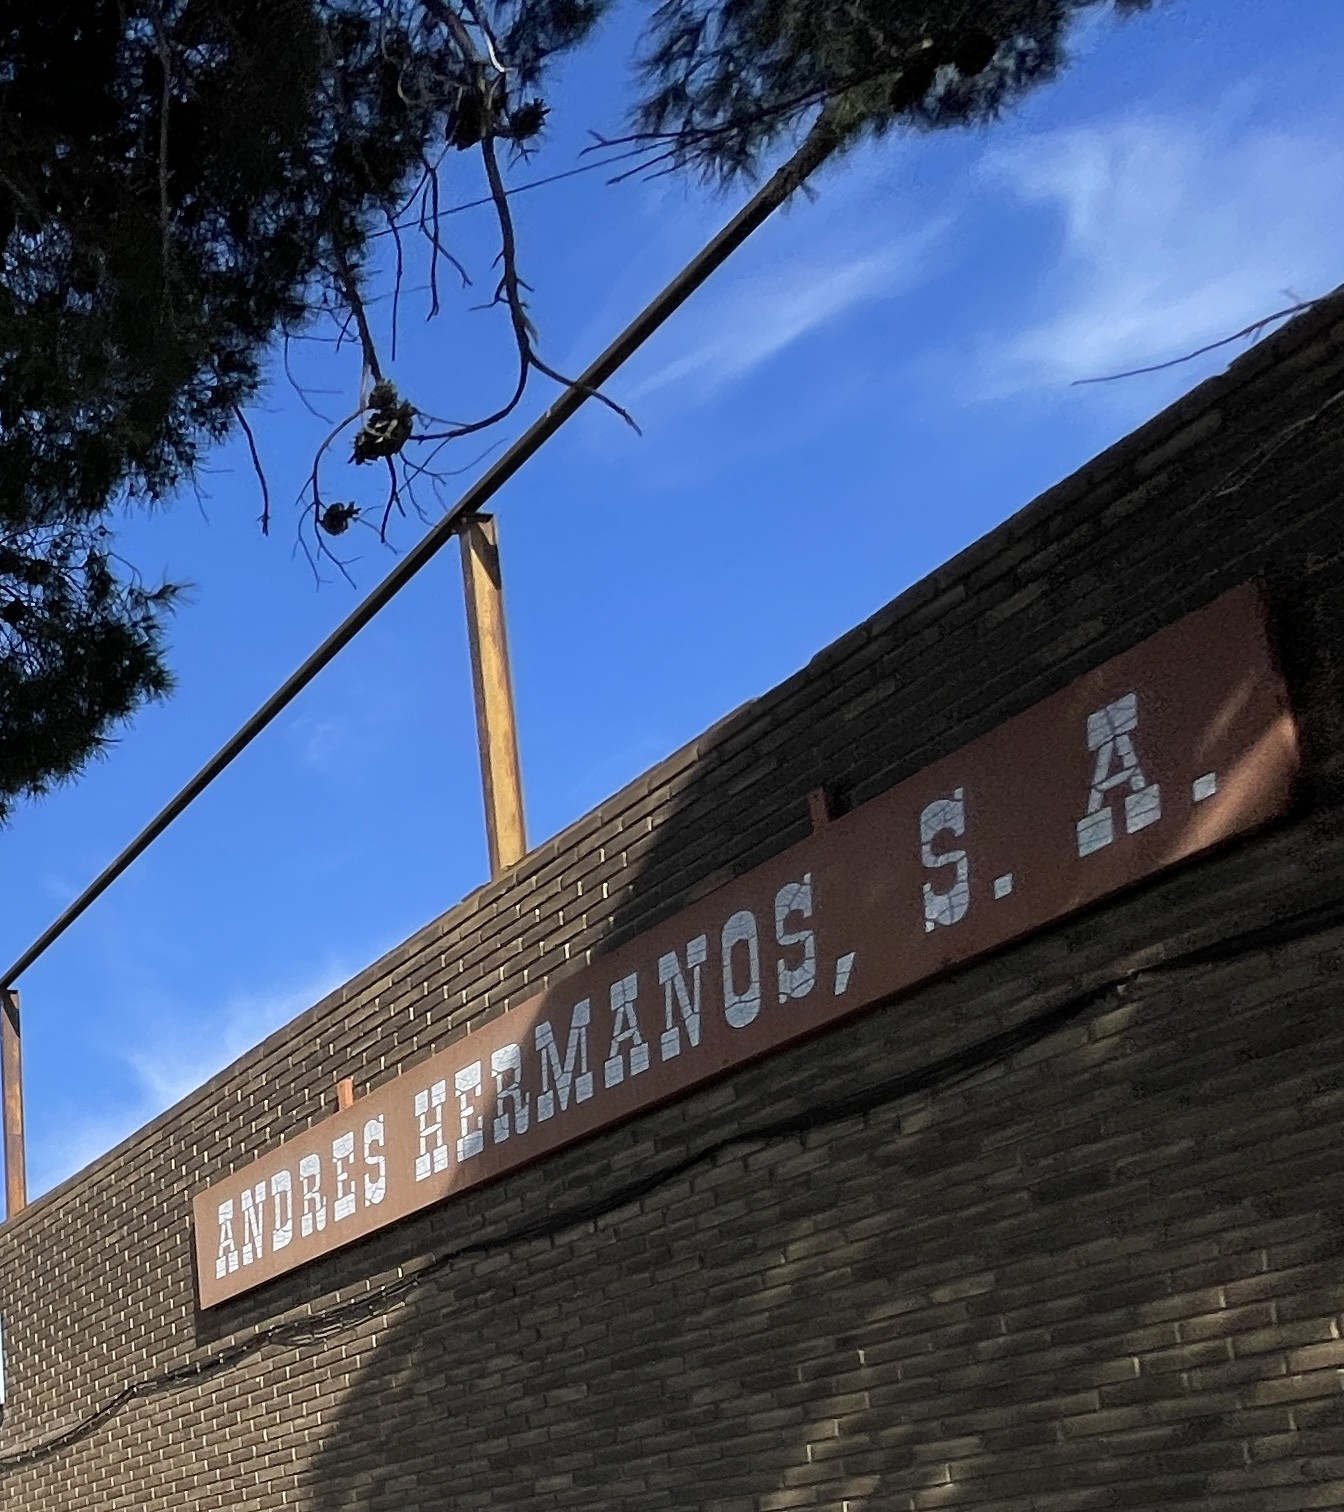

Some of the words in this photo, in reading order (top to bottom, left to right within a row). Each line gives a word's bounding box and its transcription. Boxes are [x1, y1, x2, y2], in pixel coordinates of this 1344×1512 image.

[214, 1114, 387, 1279] ANDRES
[414, 872, 858, 1183] HERMANOS,
[919, 787, 1014, 934] S.
[1075, 693, 1218, 857] A.
